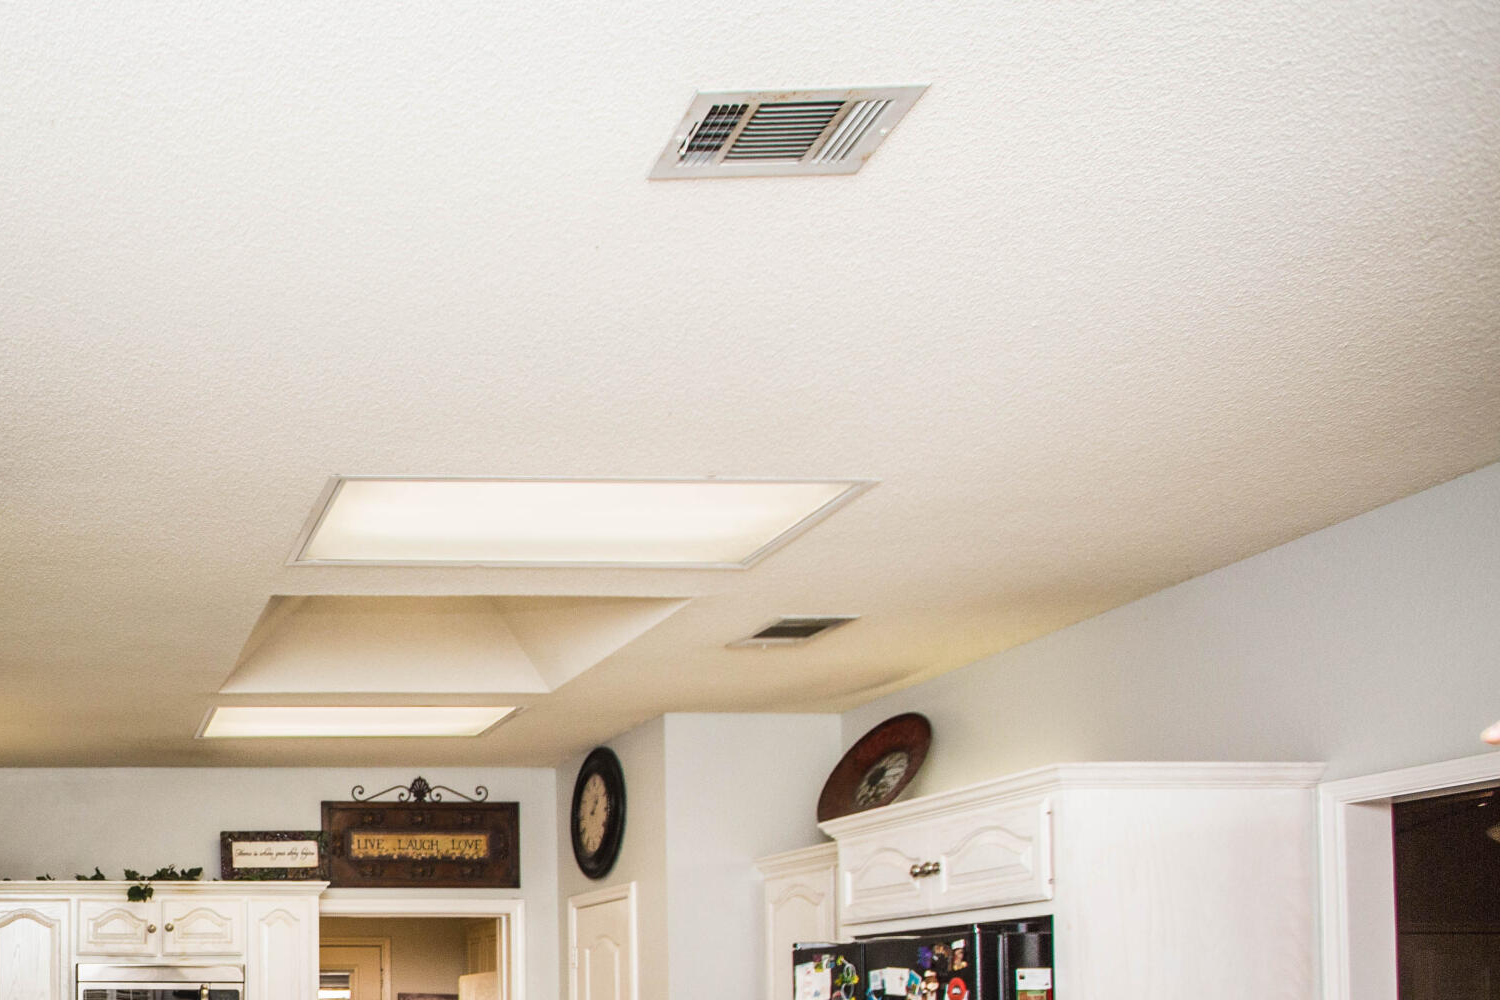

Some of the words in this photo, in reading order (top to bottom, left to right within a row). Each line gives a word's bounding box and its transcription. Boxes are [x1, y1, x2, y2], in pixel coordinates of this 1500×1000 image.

[356, 838, 385, 850] LIVE
[397, 839, 439, 851] LAUGH
[451, 838, 483, 850] LOVE
